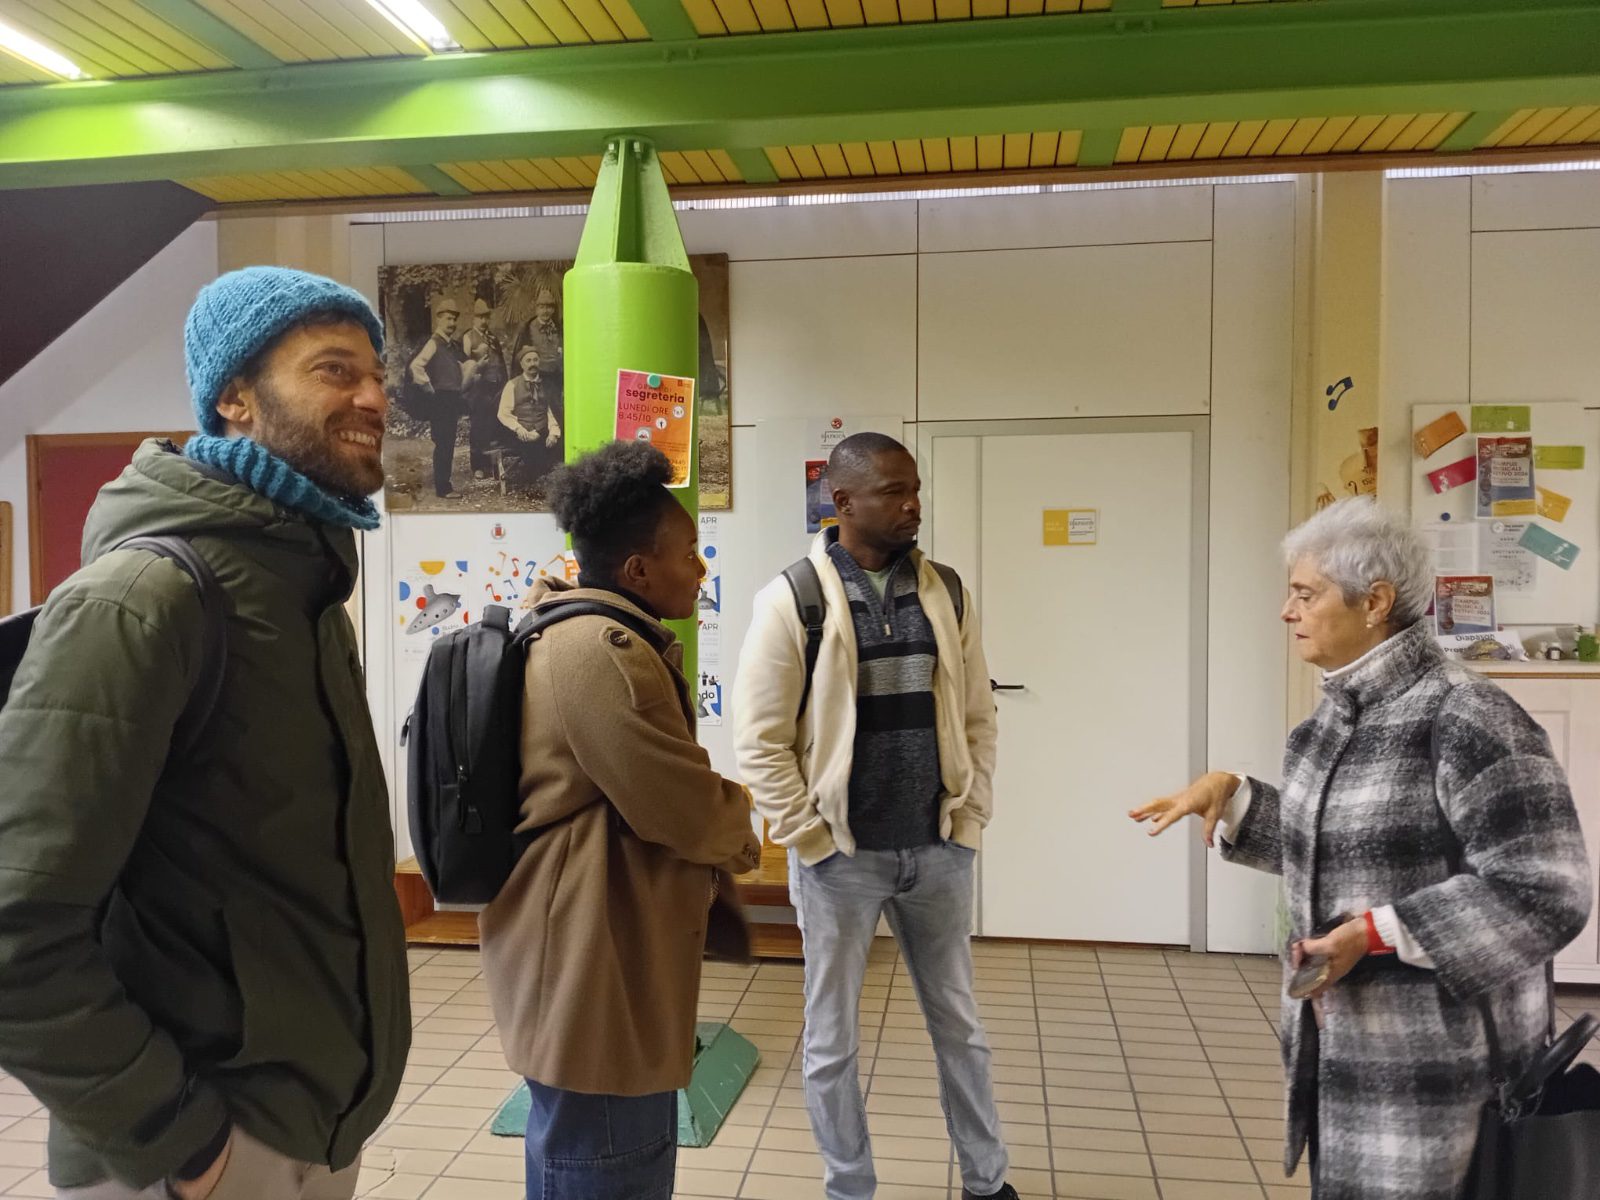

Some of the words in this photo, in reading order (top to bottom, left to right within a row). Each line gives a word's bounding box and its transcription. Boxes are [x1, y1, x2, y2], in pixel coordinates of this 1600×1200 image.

[626, 389, 685, 403] segreteria
[652, 406, 670, 416] ORE
[700, 516, 718, 524] APR
[701, 623, 719, 631] APR
